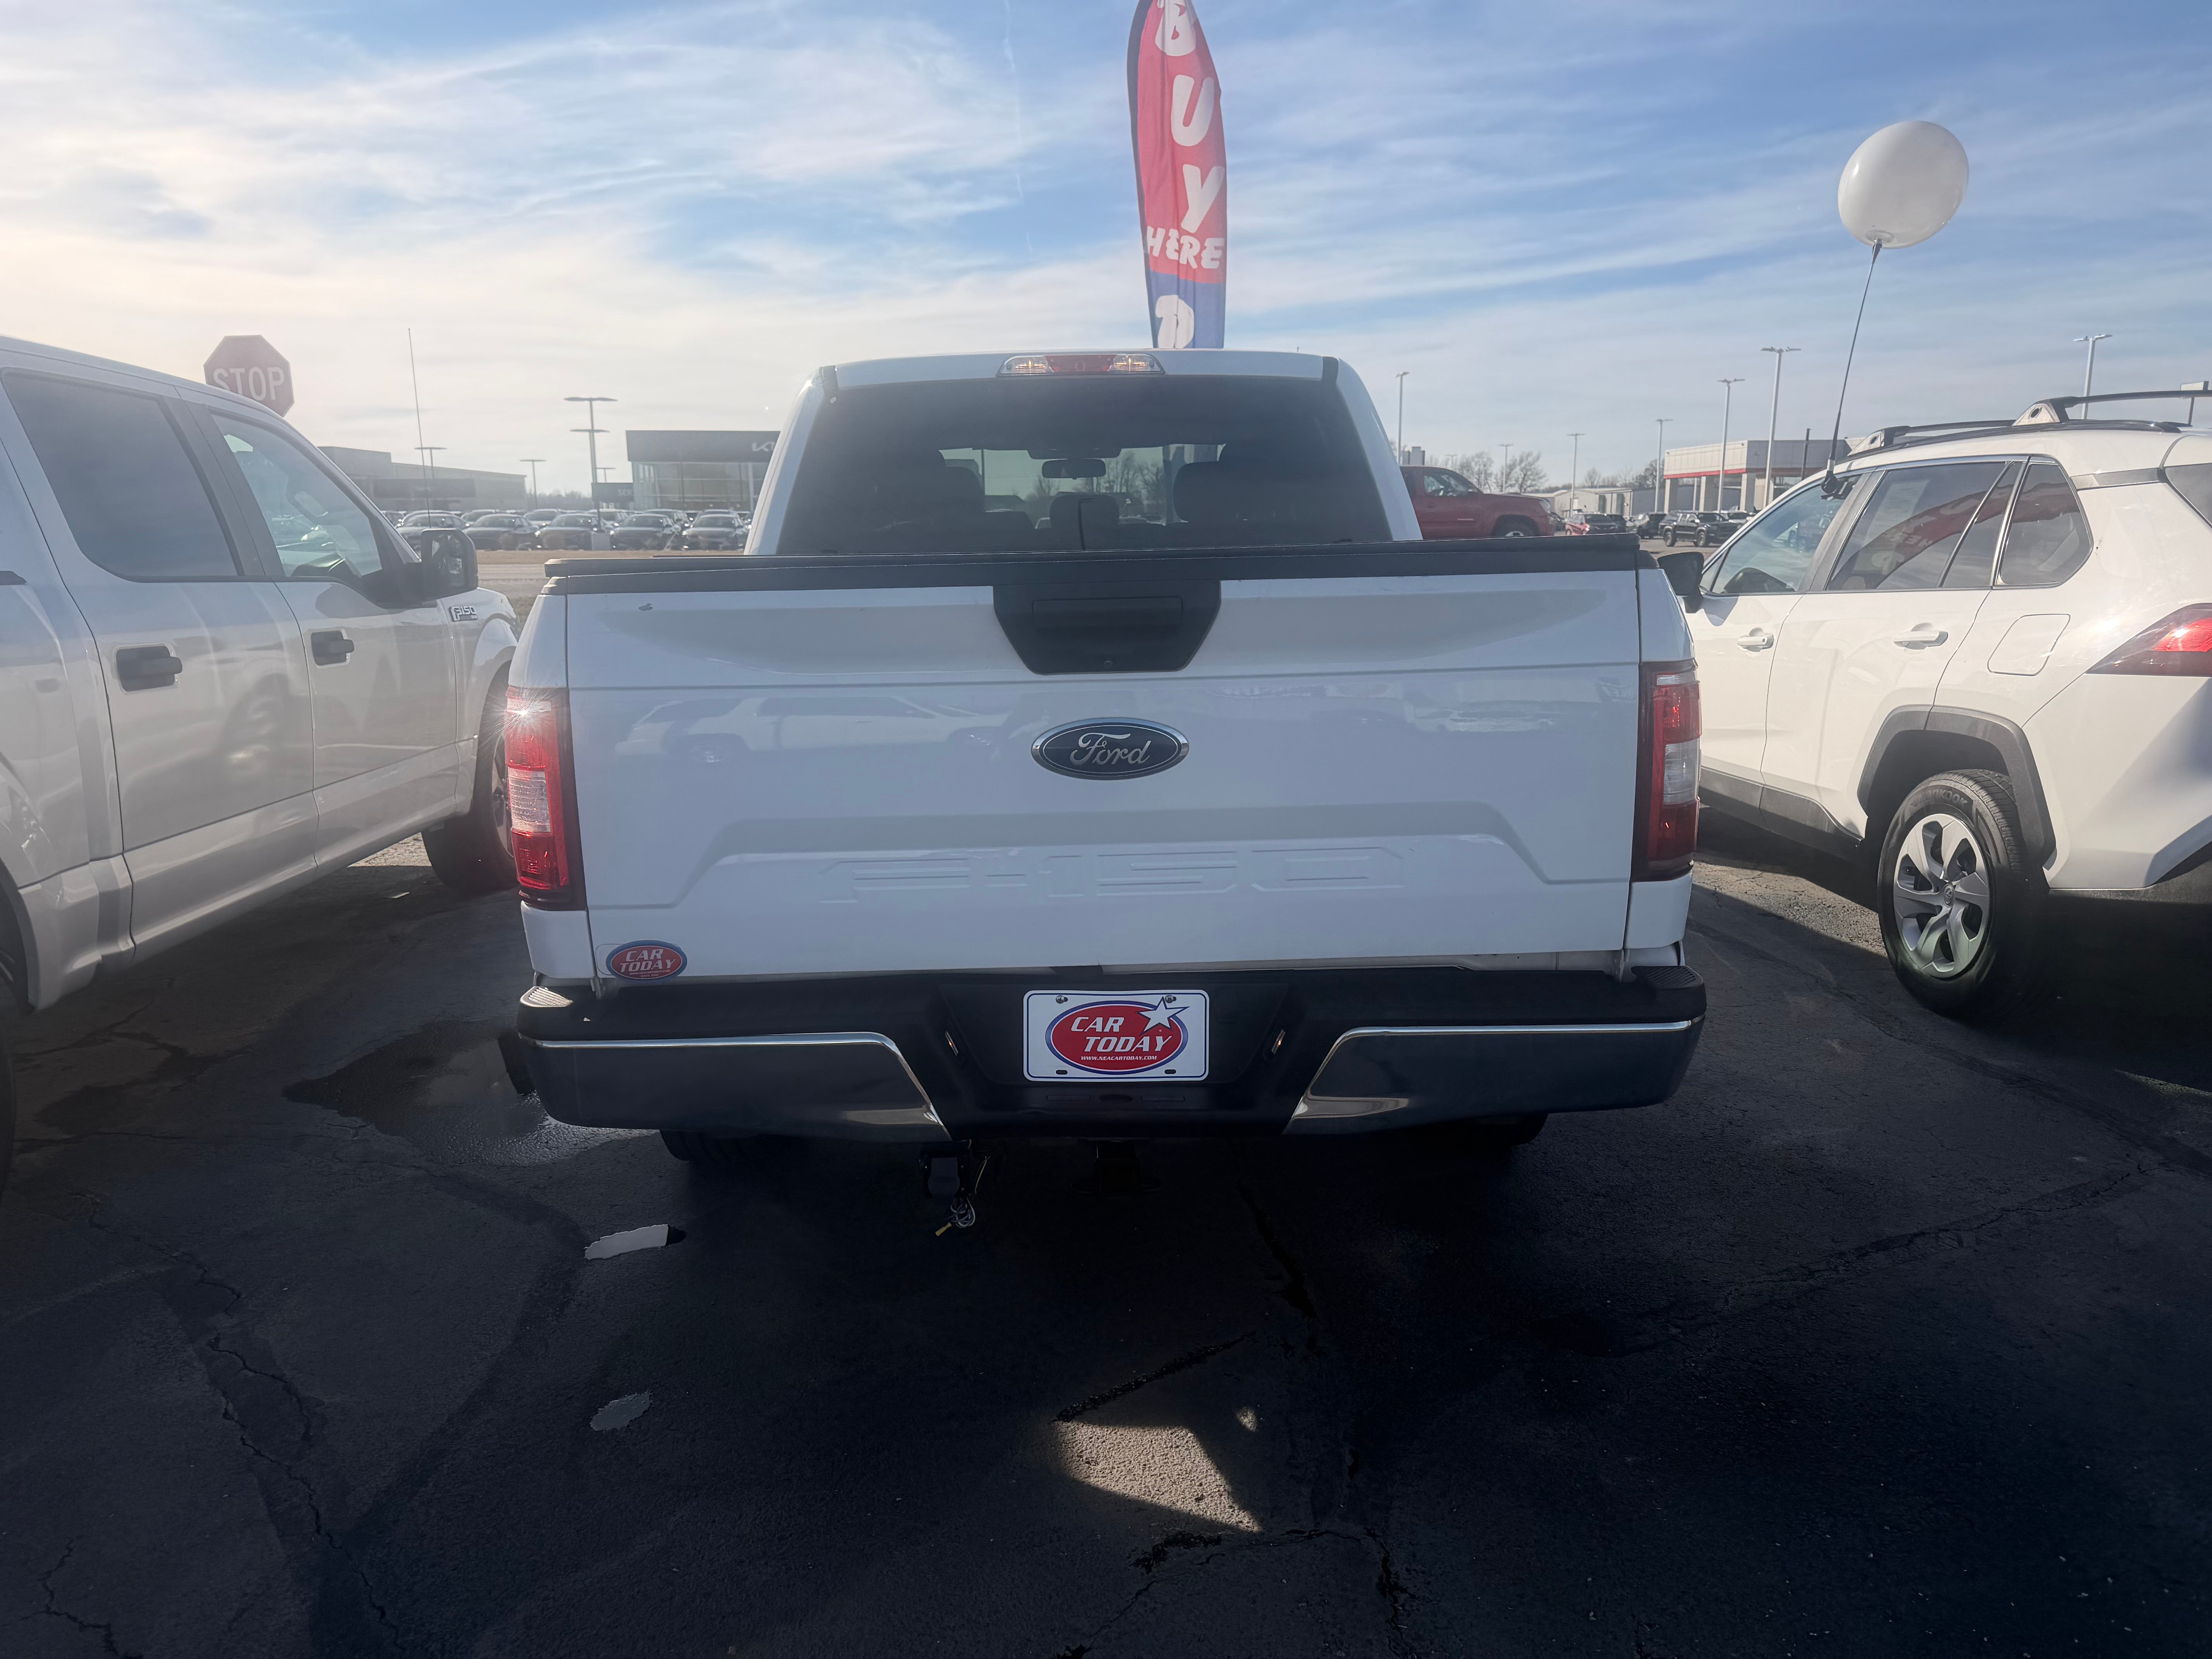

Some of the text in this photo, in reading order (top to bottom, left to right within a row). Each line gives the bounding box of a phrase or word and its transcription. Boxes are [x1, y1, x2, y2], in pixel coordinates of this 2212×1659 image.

[1155, 0, 1224, 233] BUY
[1147, 226, 1224, 269] HERE
[213, 367, 285, 401] STOP
[1070, 732, 1152, 765] Ford
[620, 959, 676, 972] TODAY
[626, 949, 663, 962] CAR
[1071, 1017, 1125, 1032] CAR
[1084, 1036, 1173, 1052] TODAY
